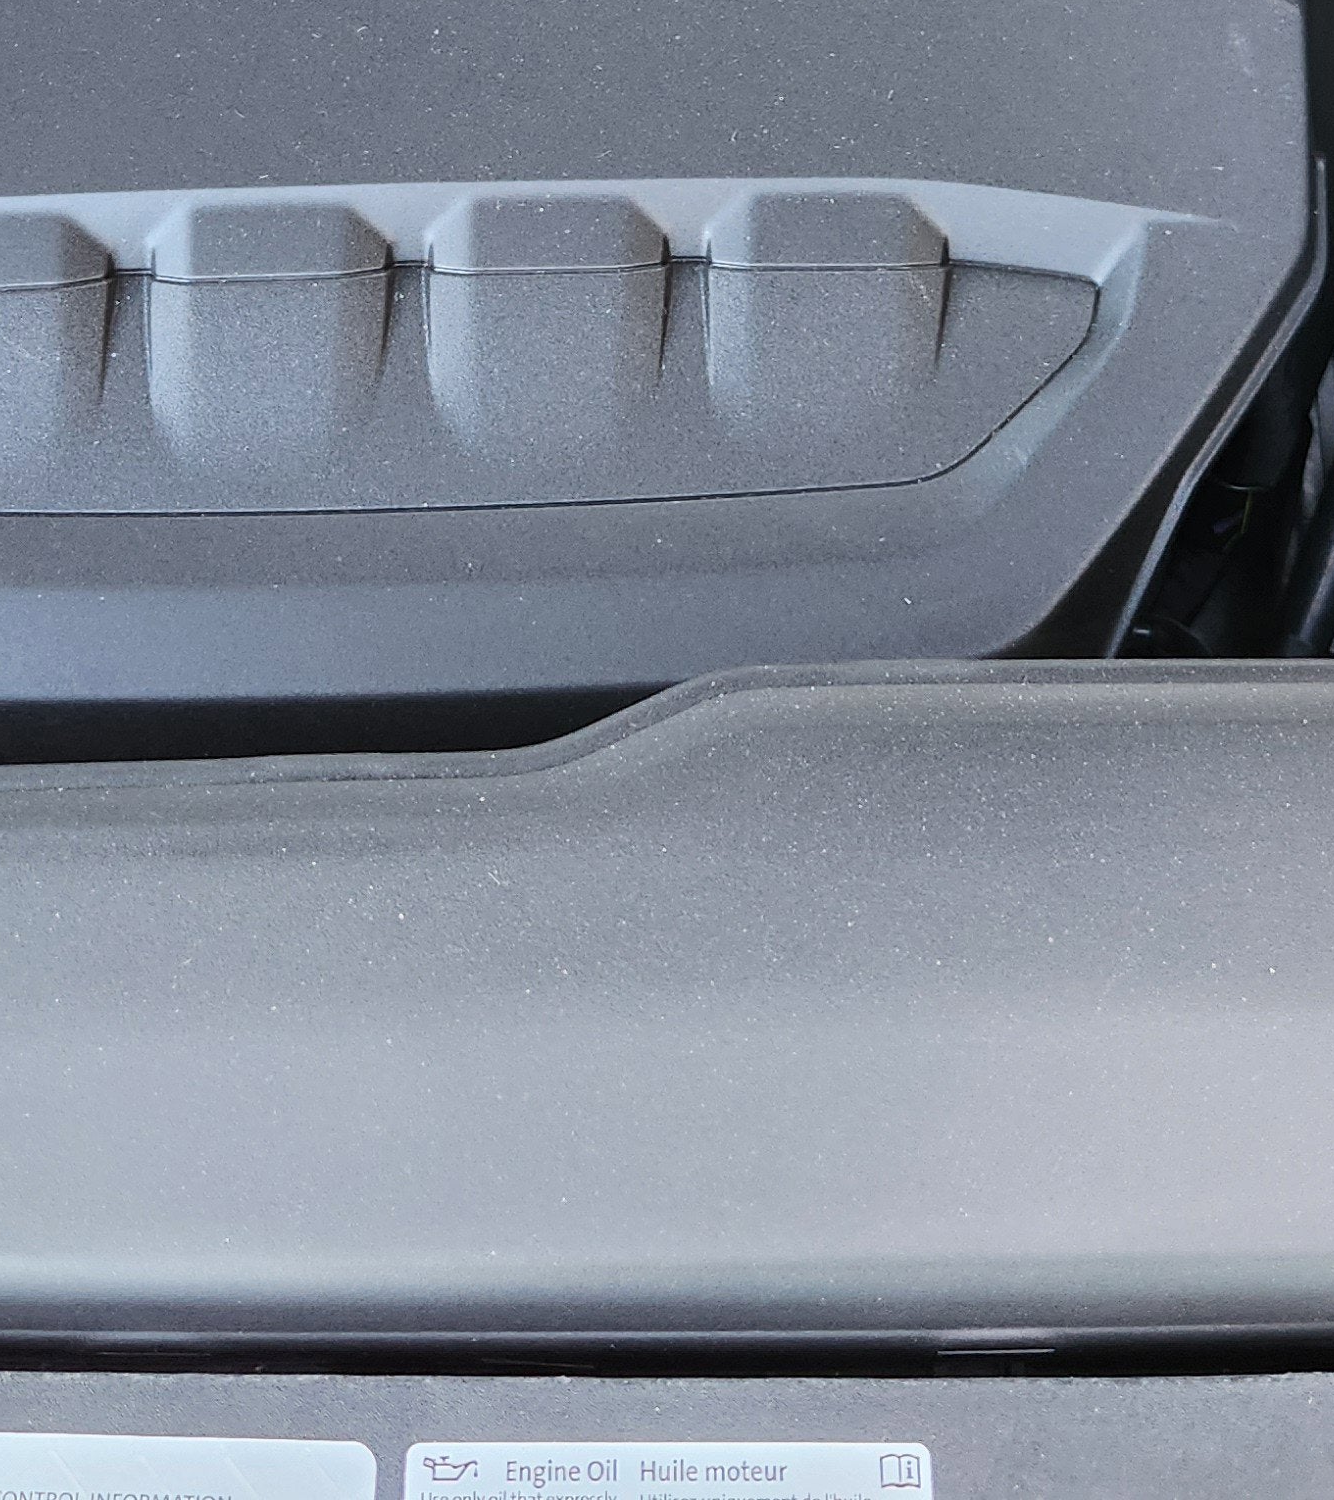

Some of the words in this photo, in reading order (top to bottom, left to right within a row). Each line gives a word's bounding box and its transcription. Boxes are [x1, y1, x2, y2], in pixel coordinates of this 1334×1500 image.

[506, 1459, 581, 1489] Engine
[587, 1459, 618, 1482] Oil
[640, 1459, 698, 1482] Huile
[705, 1461, 788, 1482] moteur
